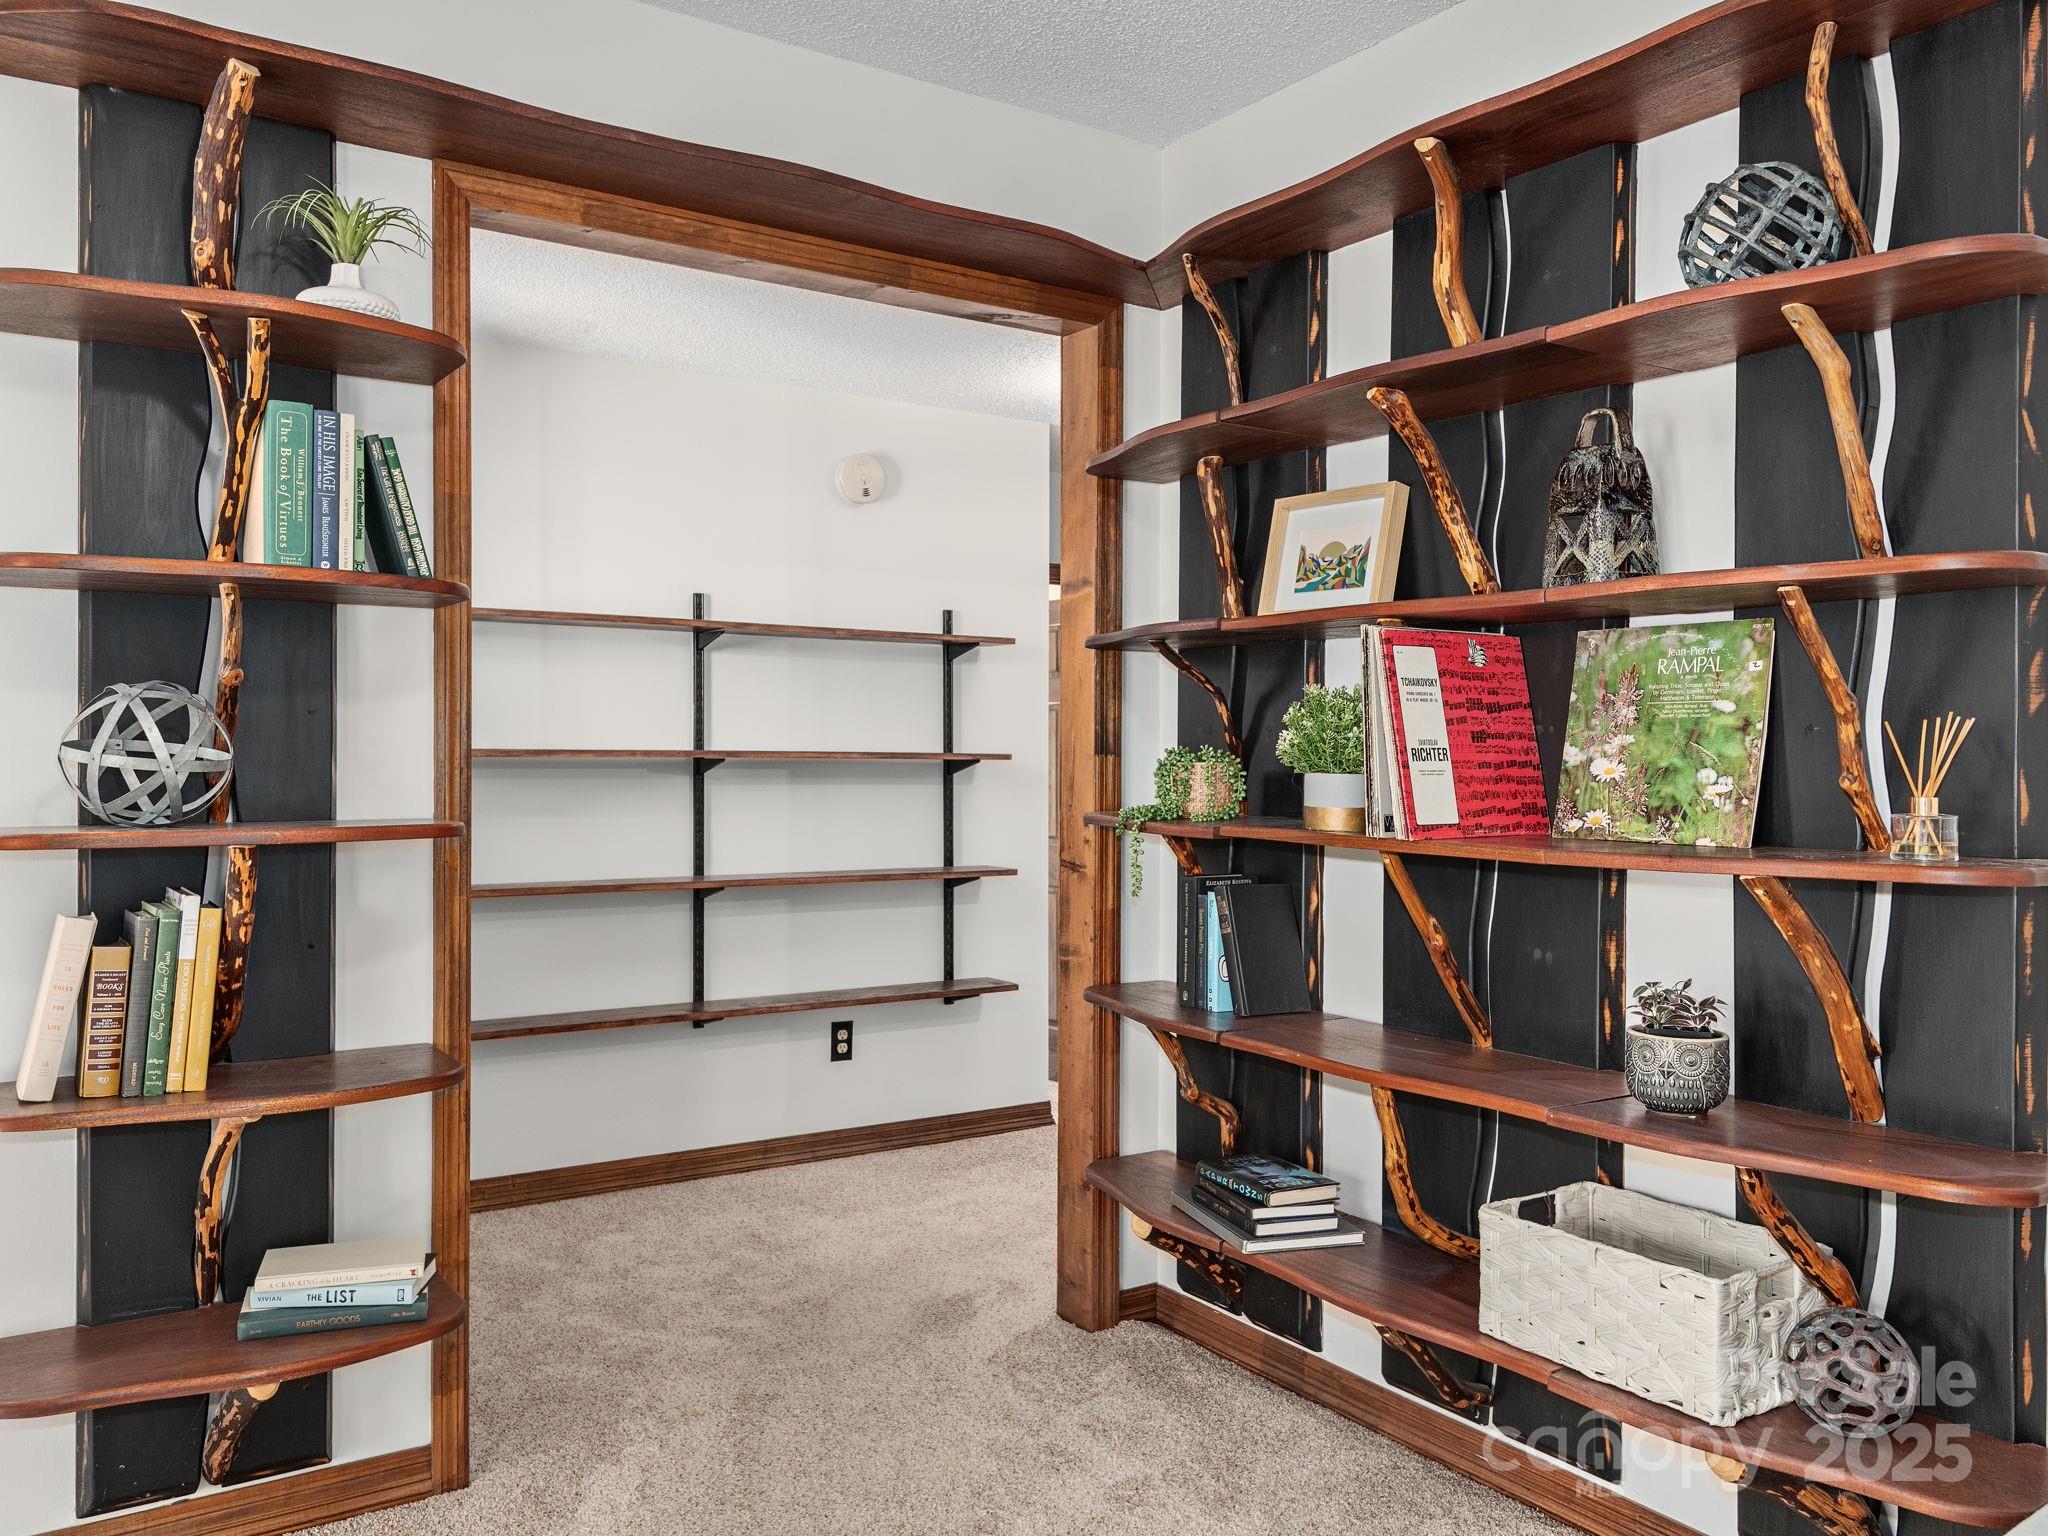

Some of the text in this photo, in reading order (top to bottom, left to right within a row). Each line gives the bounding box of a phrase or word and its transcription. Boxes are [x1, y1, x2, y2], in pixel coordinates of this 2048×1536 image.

[322, 415, 336, 491] IN HIS IMAGE
[297, 449, 305, 478] William
[277, 416, 293, 548] The Book of Virtues
[357, 479, 365, 497] Secret
[356, 525, 365, 540] Living
[1667, 645, 1717, 658] Jean-Pierre
[1657, 655, 1724, 675] RAMPAL
[1400, 677, 1438, 688] TCHAIKOVSKY
[1411, 747, 1449, 762] RICHTER
[96, 983, 124, 991] BOOKS
[179, 962, 192, 1012] DISCOVERERS
[151, 951, 171, 1040] Easy Care Native Plants
[1200, 1167, 1229, 1186] PAPER
[1233, 1181, 1264, 1201] TOWNS
[275, 1279, 317, 1289] CRACKING
[307, 1289, 357, 1303] THE LIST
[296, 1314, 361, 1329] EARTHLY GOODS
